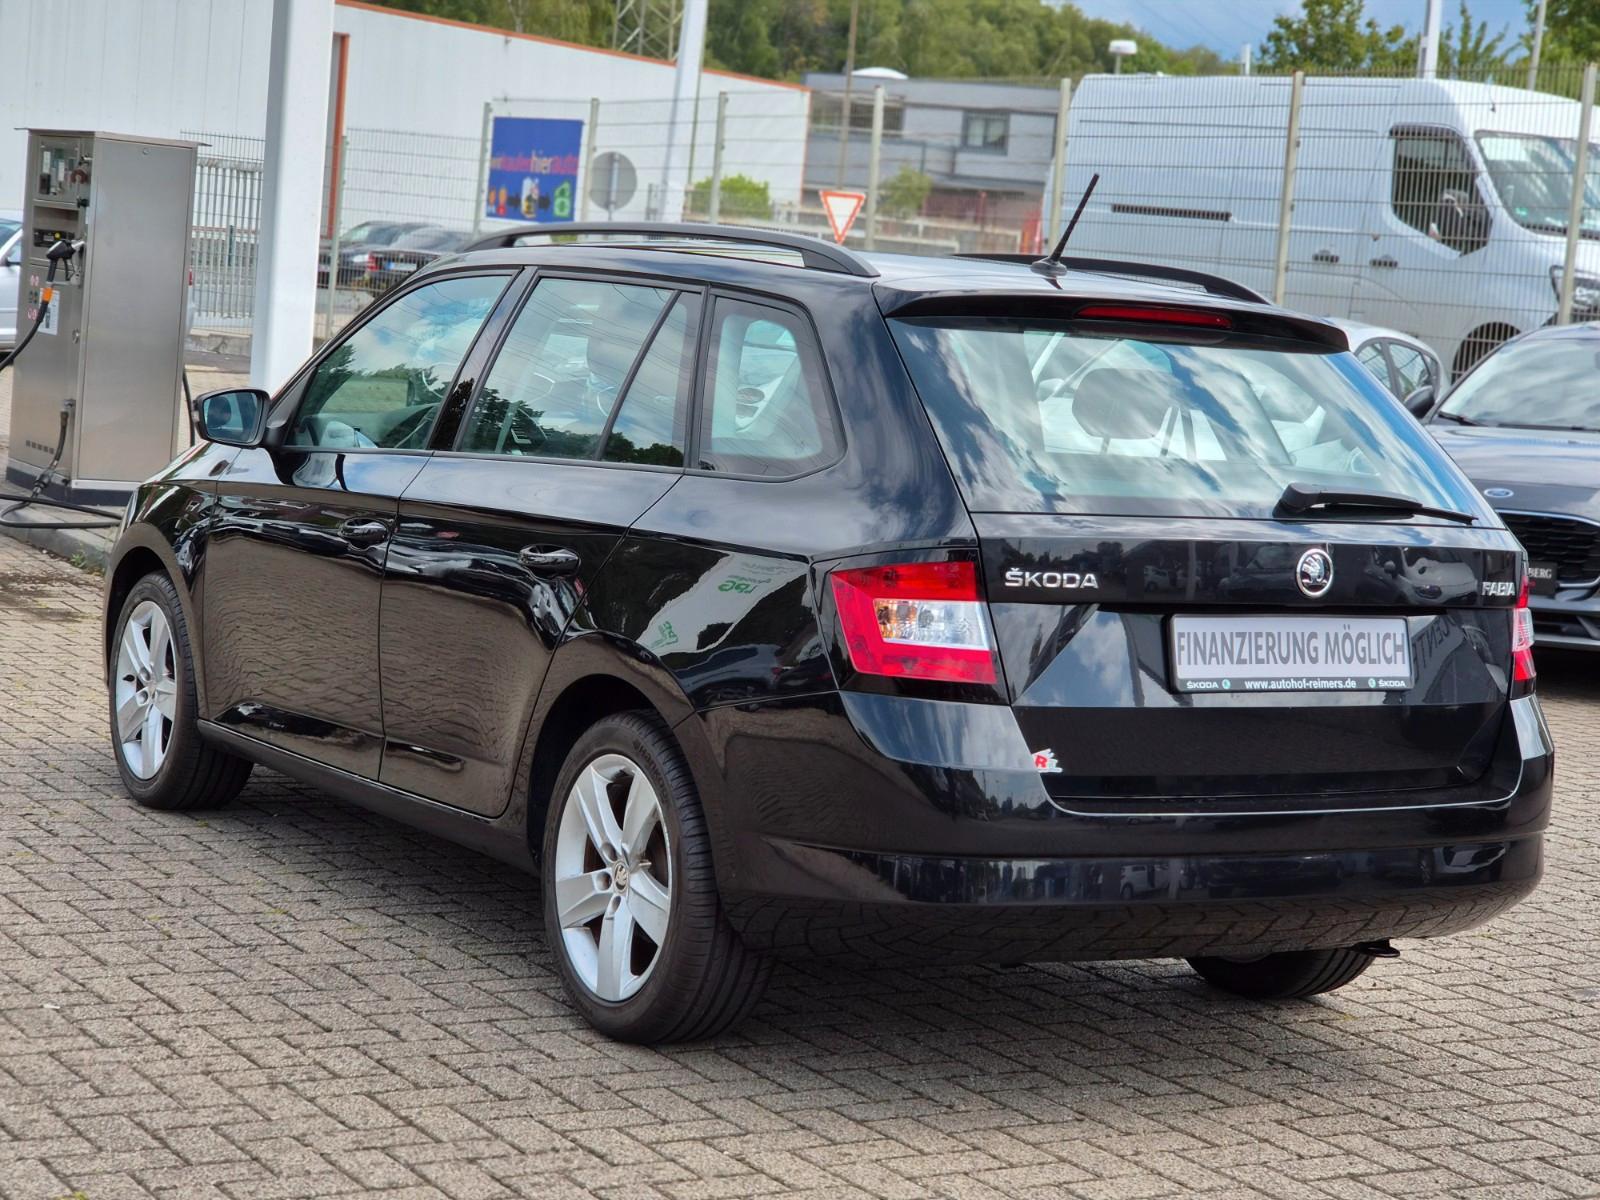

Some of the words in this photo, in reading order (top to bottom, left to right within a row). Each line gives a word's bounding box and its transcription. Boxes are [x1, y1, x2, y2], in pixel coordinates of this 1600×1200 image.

[1004, 567, 1099, 589] ŠKODA
[1481, 581, 1516, 597] FABIA
[1177, 631, 1319, 665] FINANZIERUNG
[1324, 623, 1406, 665] MÖGLICH
[1244, 678, 1357, 690] www.autohof-reimers.de
